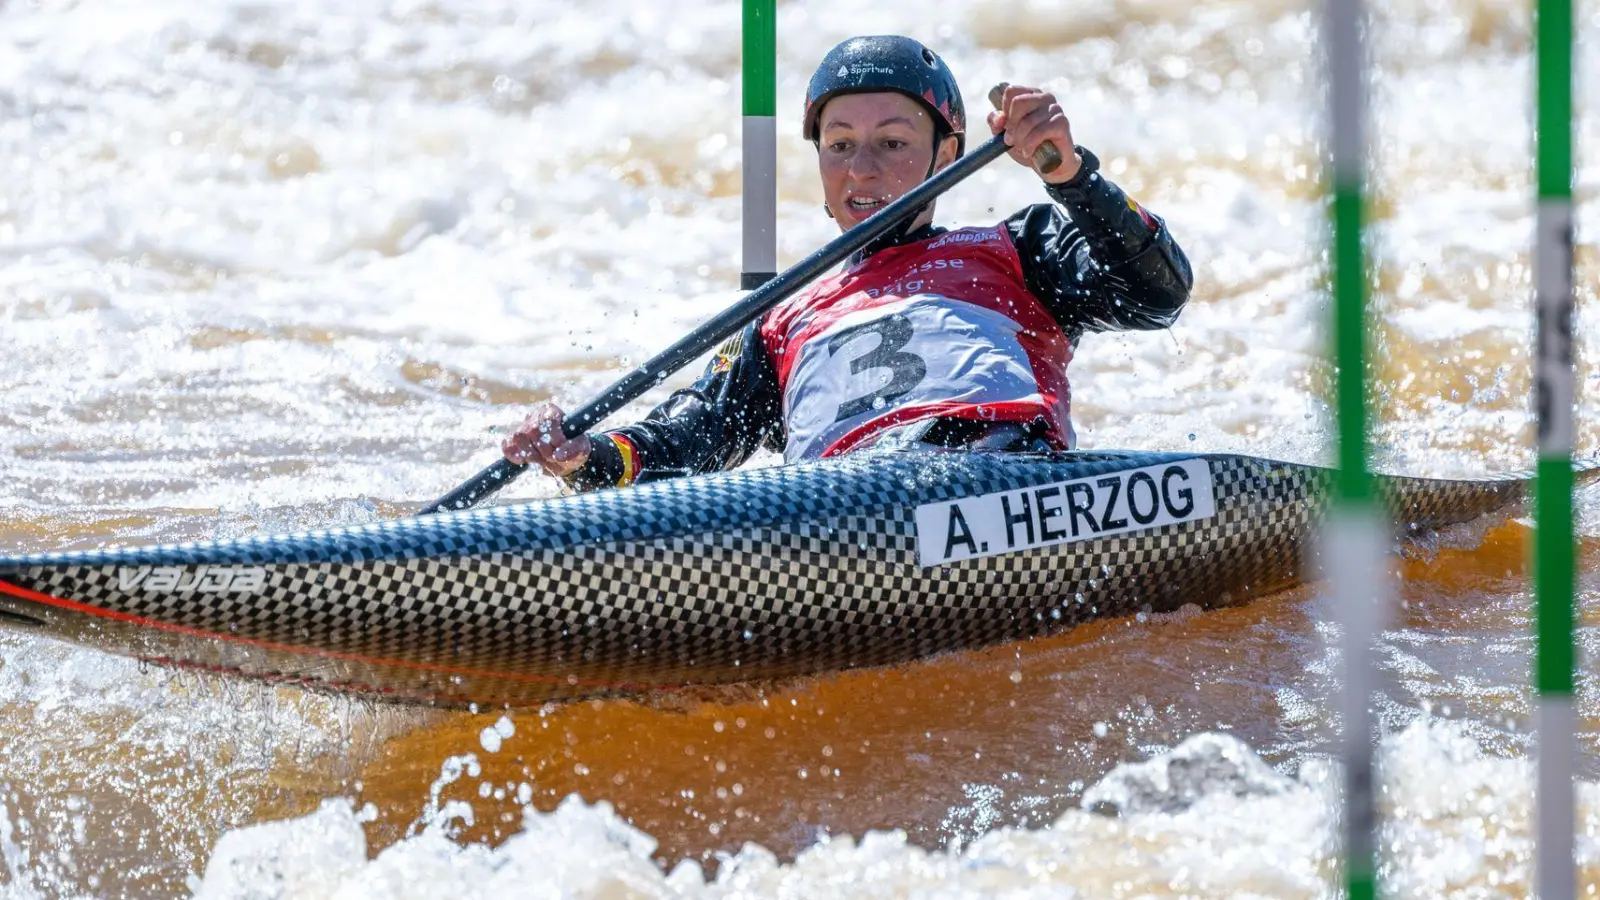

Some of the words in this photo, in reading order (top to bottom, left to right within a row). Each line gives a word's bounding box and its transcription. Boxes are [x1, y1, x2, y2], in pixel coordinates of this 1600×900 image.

[828, 313, 926, 423] 3
[944, 504, 989, 559] A.
[1000, 465, 1195, 548] HERZOG
